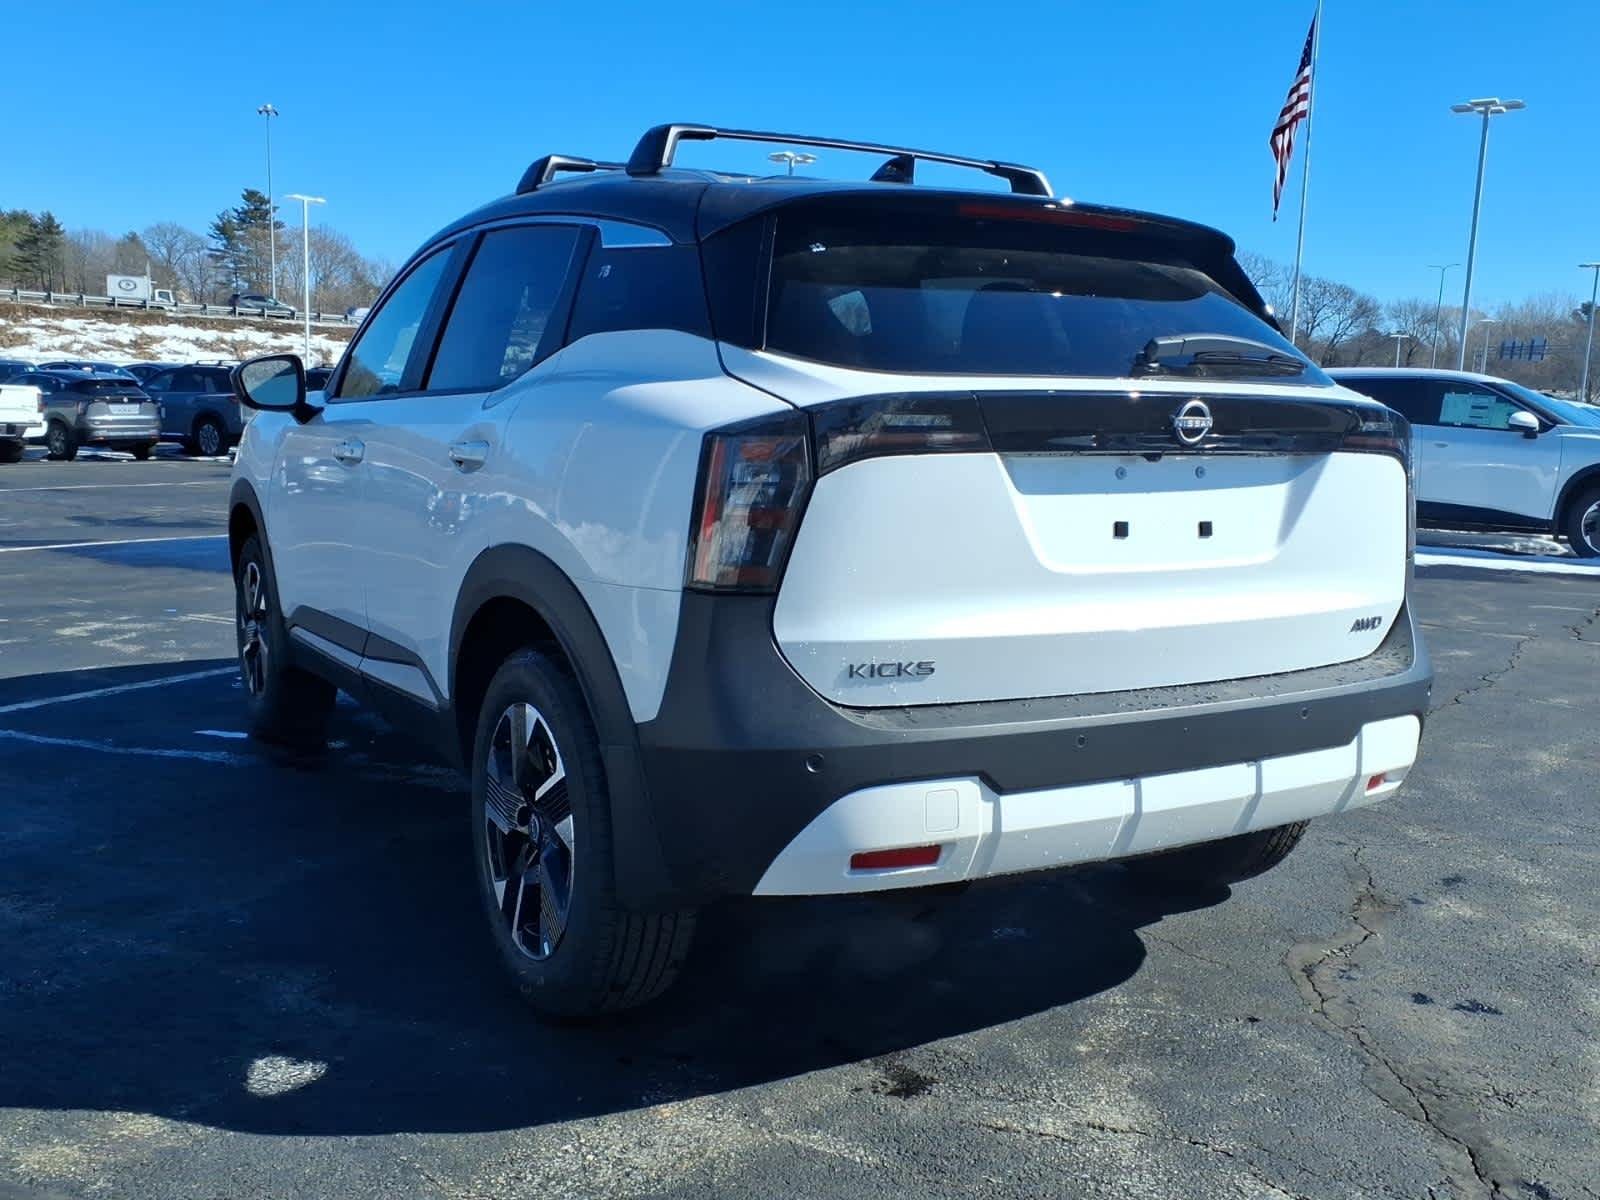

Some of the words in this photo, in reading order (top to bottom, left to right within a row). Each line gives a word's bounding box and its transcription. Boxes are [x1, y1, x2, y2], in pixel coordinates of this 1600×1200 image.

[1174, 417, 1213, 428] NISSAN
[1350, 615, 1382, 632] AWD
[848, 661, 935, 679] KICKS
